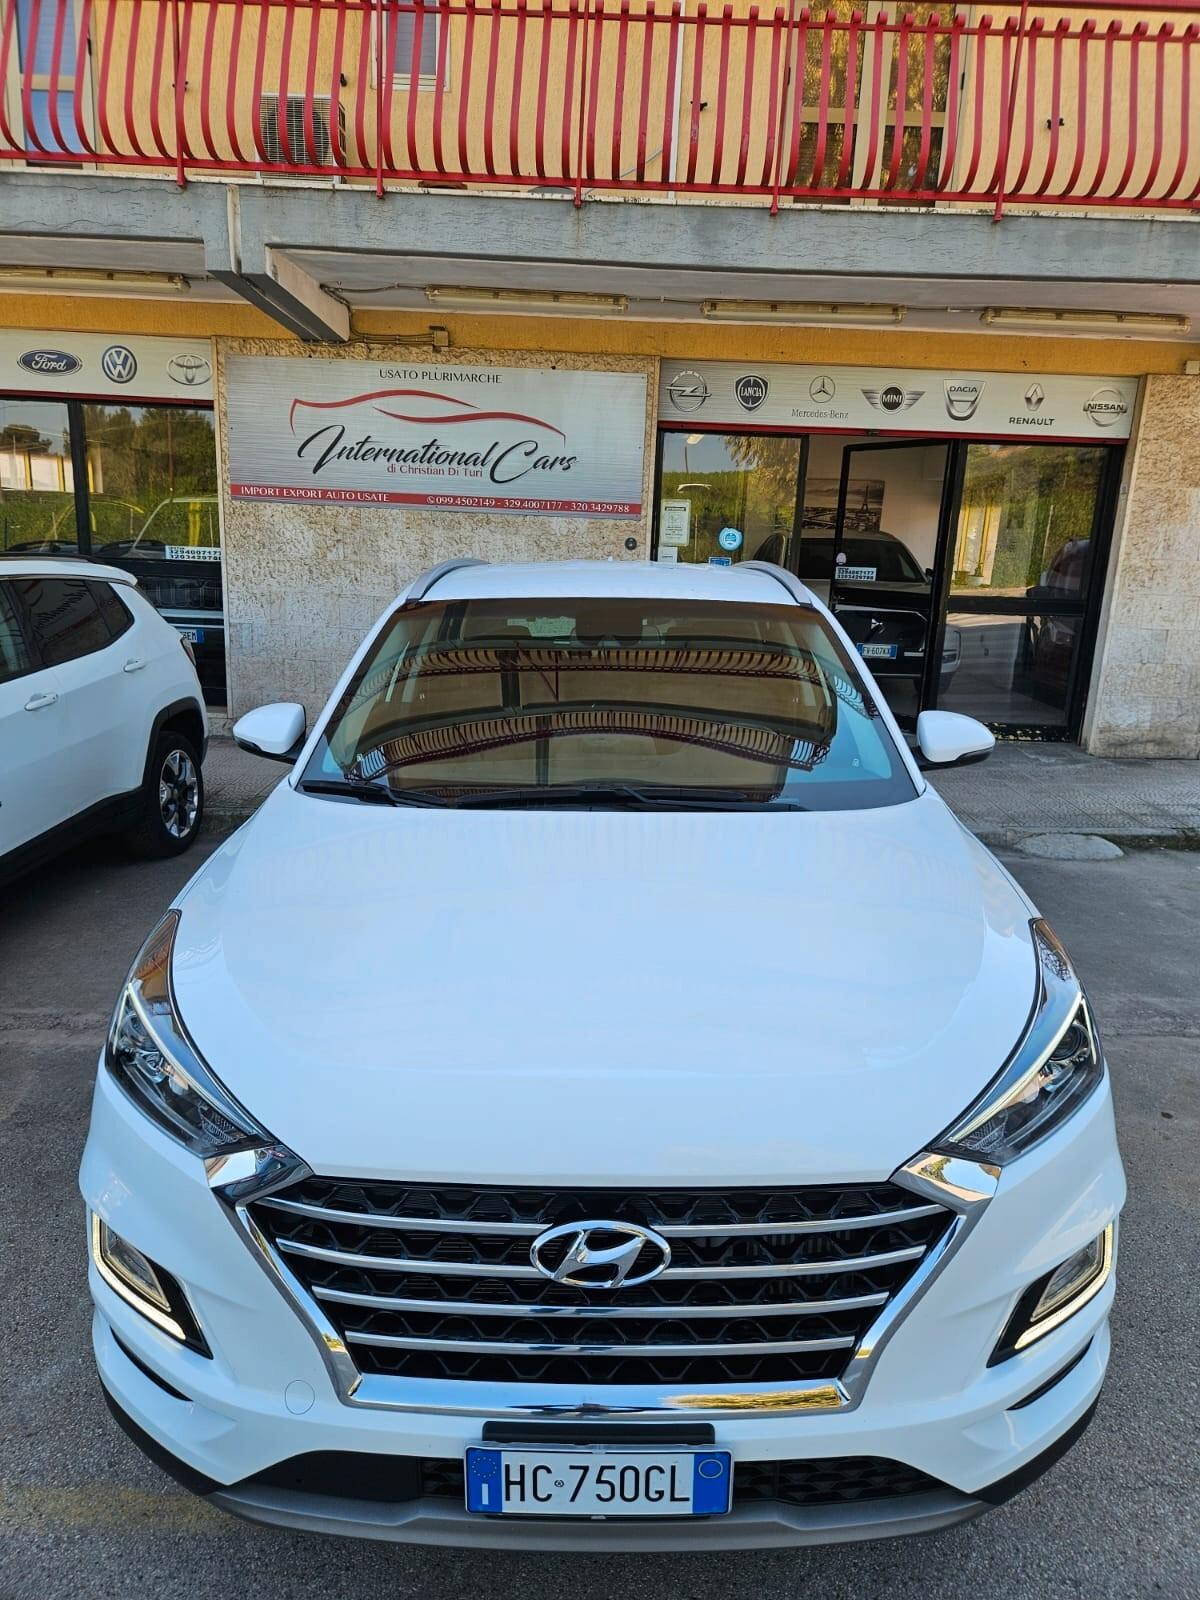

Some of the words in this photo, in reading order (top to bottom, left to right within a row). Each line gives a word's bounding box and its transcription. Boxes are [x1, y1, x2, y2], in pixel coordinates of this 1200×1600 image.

[31, 353, 68, 371] Ford
[379, 368, 419, 380] USATO
[421, 371, 502, 384] PLURIMARCHE
[740, 386, 763, 398] LANCIA
[949, 385, 978, 394] DACIA
[882, 393, 902, 404] MINI
[1087, 402, 1124, 412] NISSAN
[791, 408, 849, 419] Mercedes-Benz
[1008, 416, 1055, 426] RENAULT
[297, 424, 500, 475] International
[489, 439, 579, 484] Cars
[387, 464, 396, 474] di
[399, 465, 445, 476] Christian
[447, 467, 460, 476] Di
[463, 467, 483, 478] Turi
[241, 485, 280, 497] IMPORT
[283, 488, 323, 499] EXPORT
[325, 490, 355, 500] AUTO
[357, 492, 390, 503] USATE
[436, 496, 495, 508] 099.4502149
[503, 499, 563, 510] 329.4007177
[570, 502, 630, 513] 320.3429788
